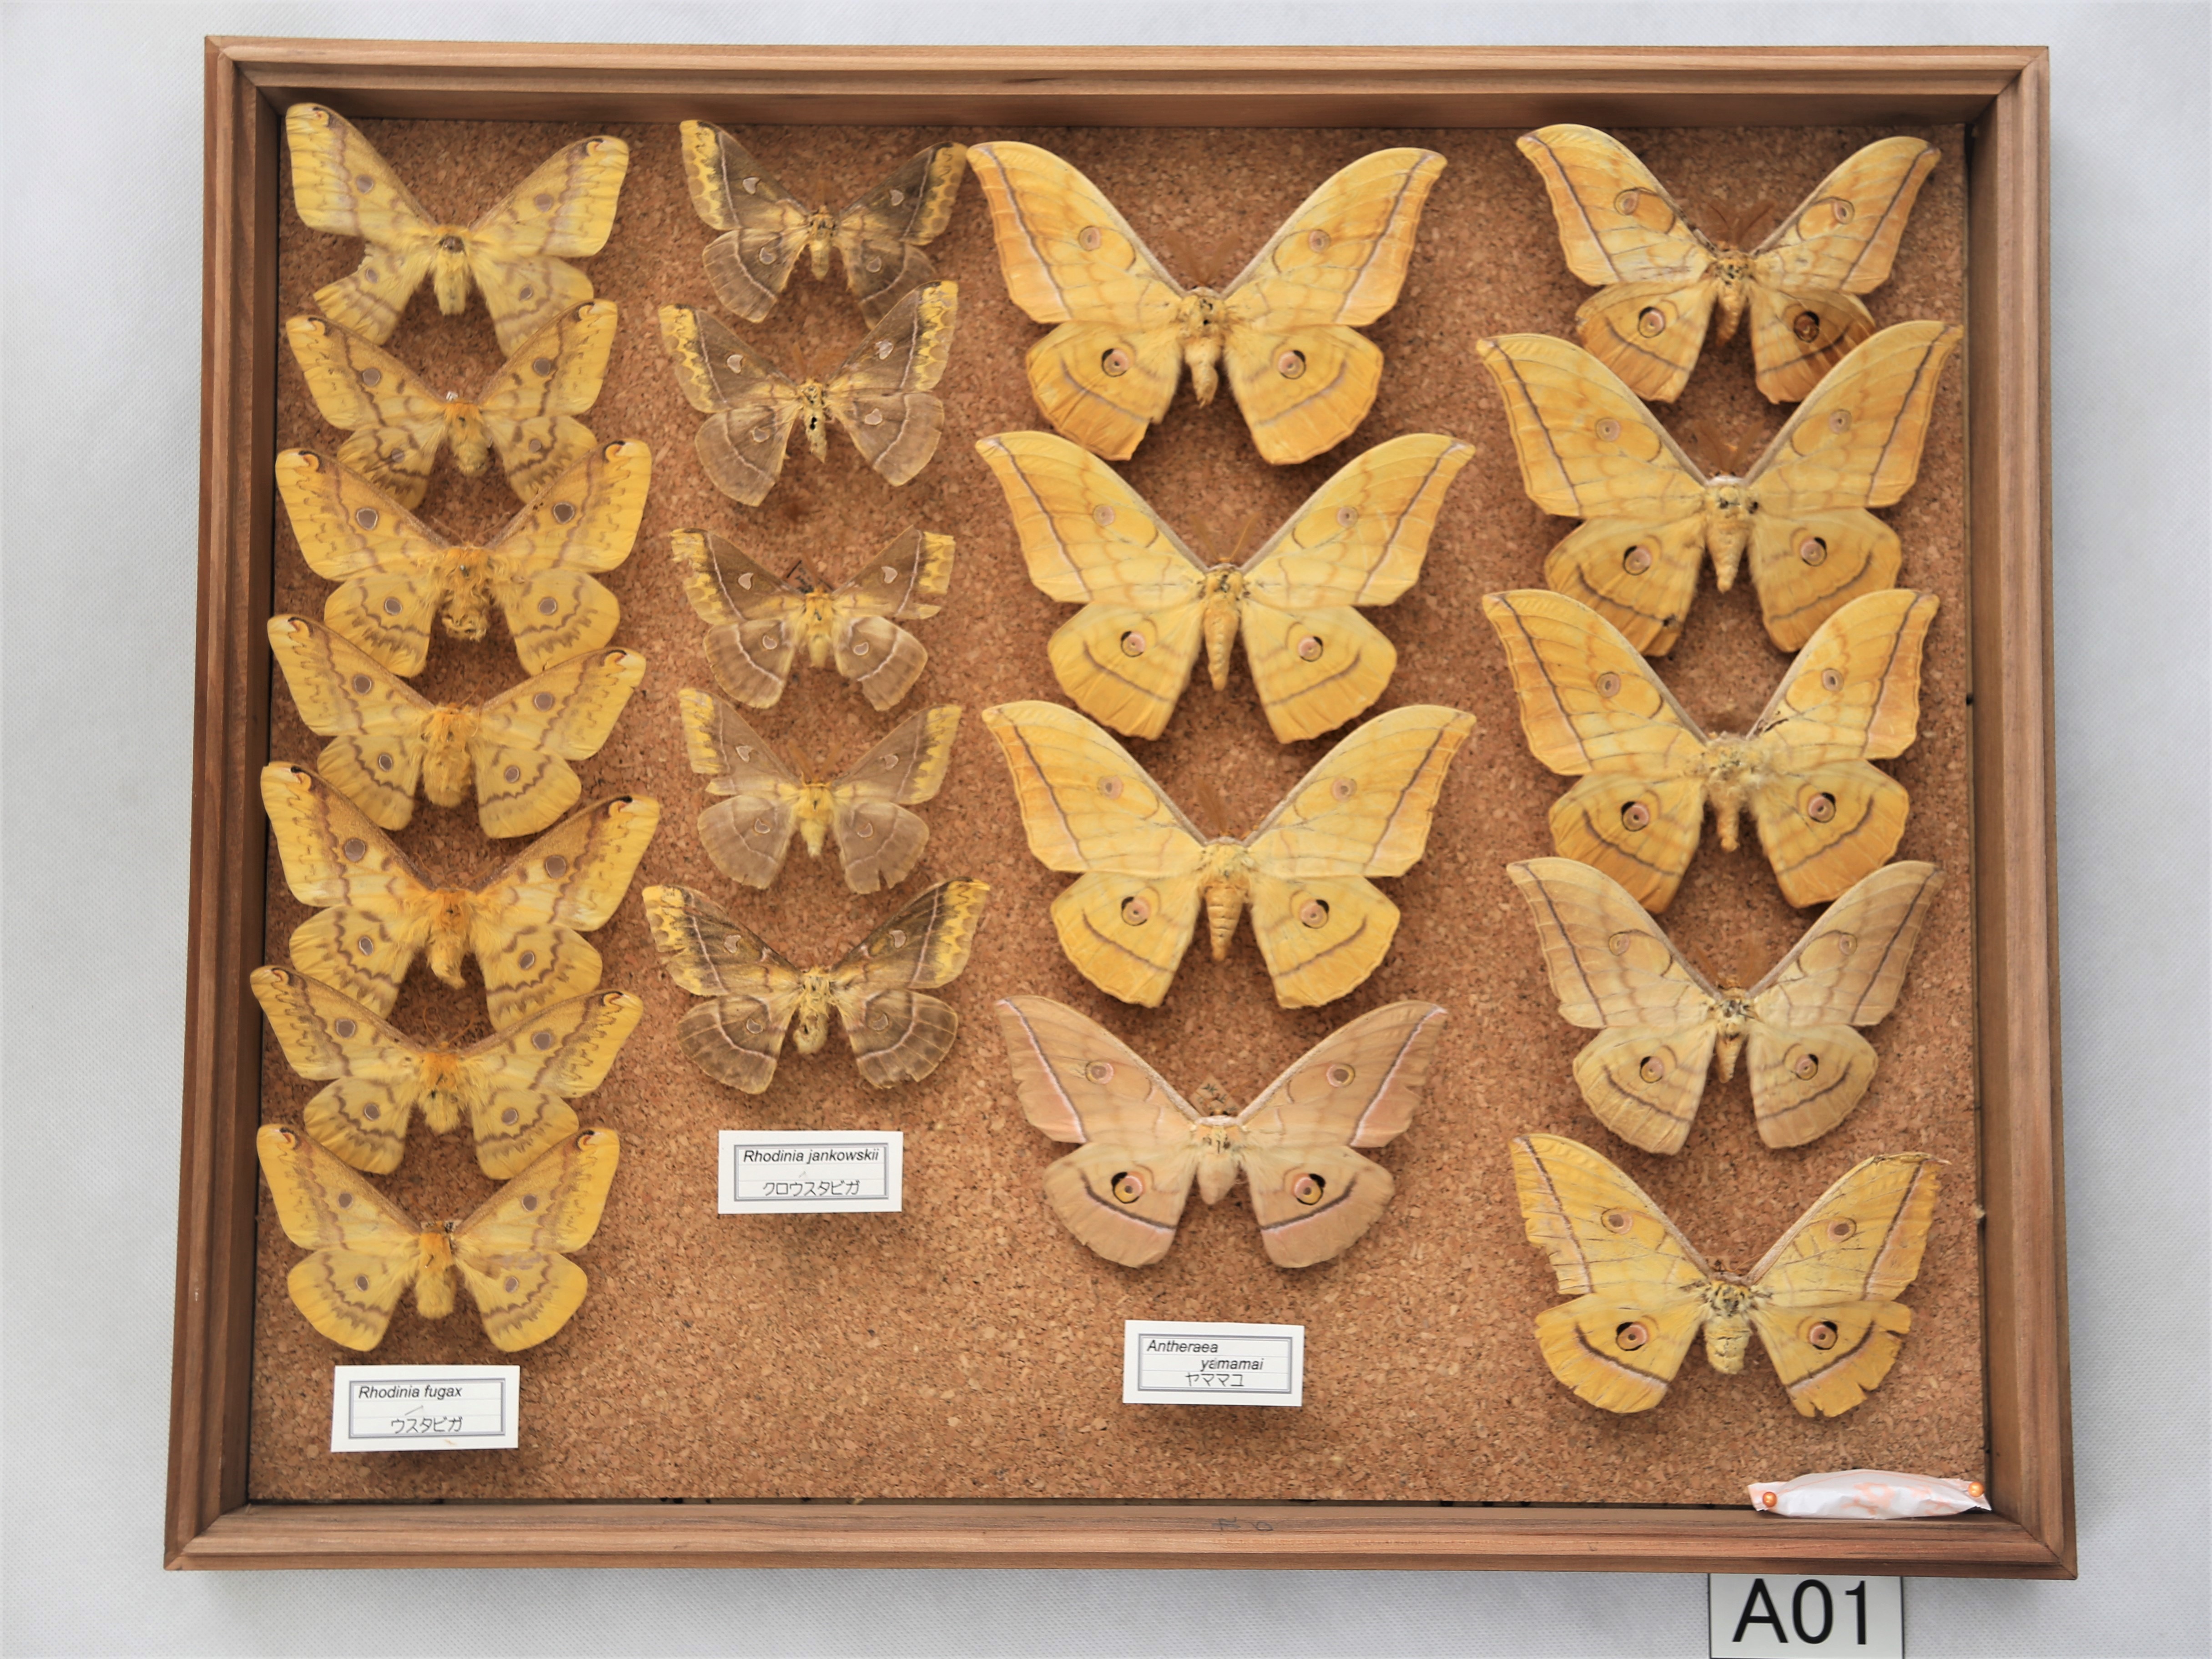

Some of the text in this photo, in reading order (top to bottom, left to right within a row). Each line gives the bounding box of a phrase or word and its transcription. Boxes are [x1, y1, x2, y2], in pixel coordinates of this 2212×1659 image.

[743, 1148, 879, 1165] Rhodinia jankowskii
[763, 1180, 860, 1197] クロウスタビガ
[1146, 1339, 1219, 1353] Antheraea
[1200, 1358, 1264, 1372] yamamai
[1185, 1372, 1245, 1387] ヤママユ
[358, 1384, 462, 1400] Rhodinia fugax
[391, 1416, 463, 1434] ウスタビガ
[1732, 1578, 1867, 1645] A01
